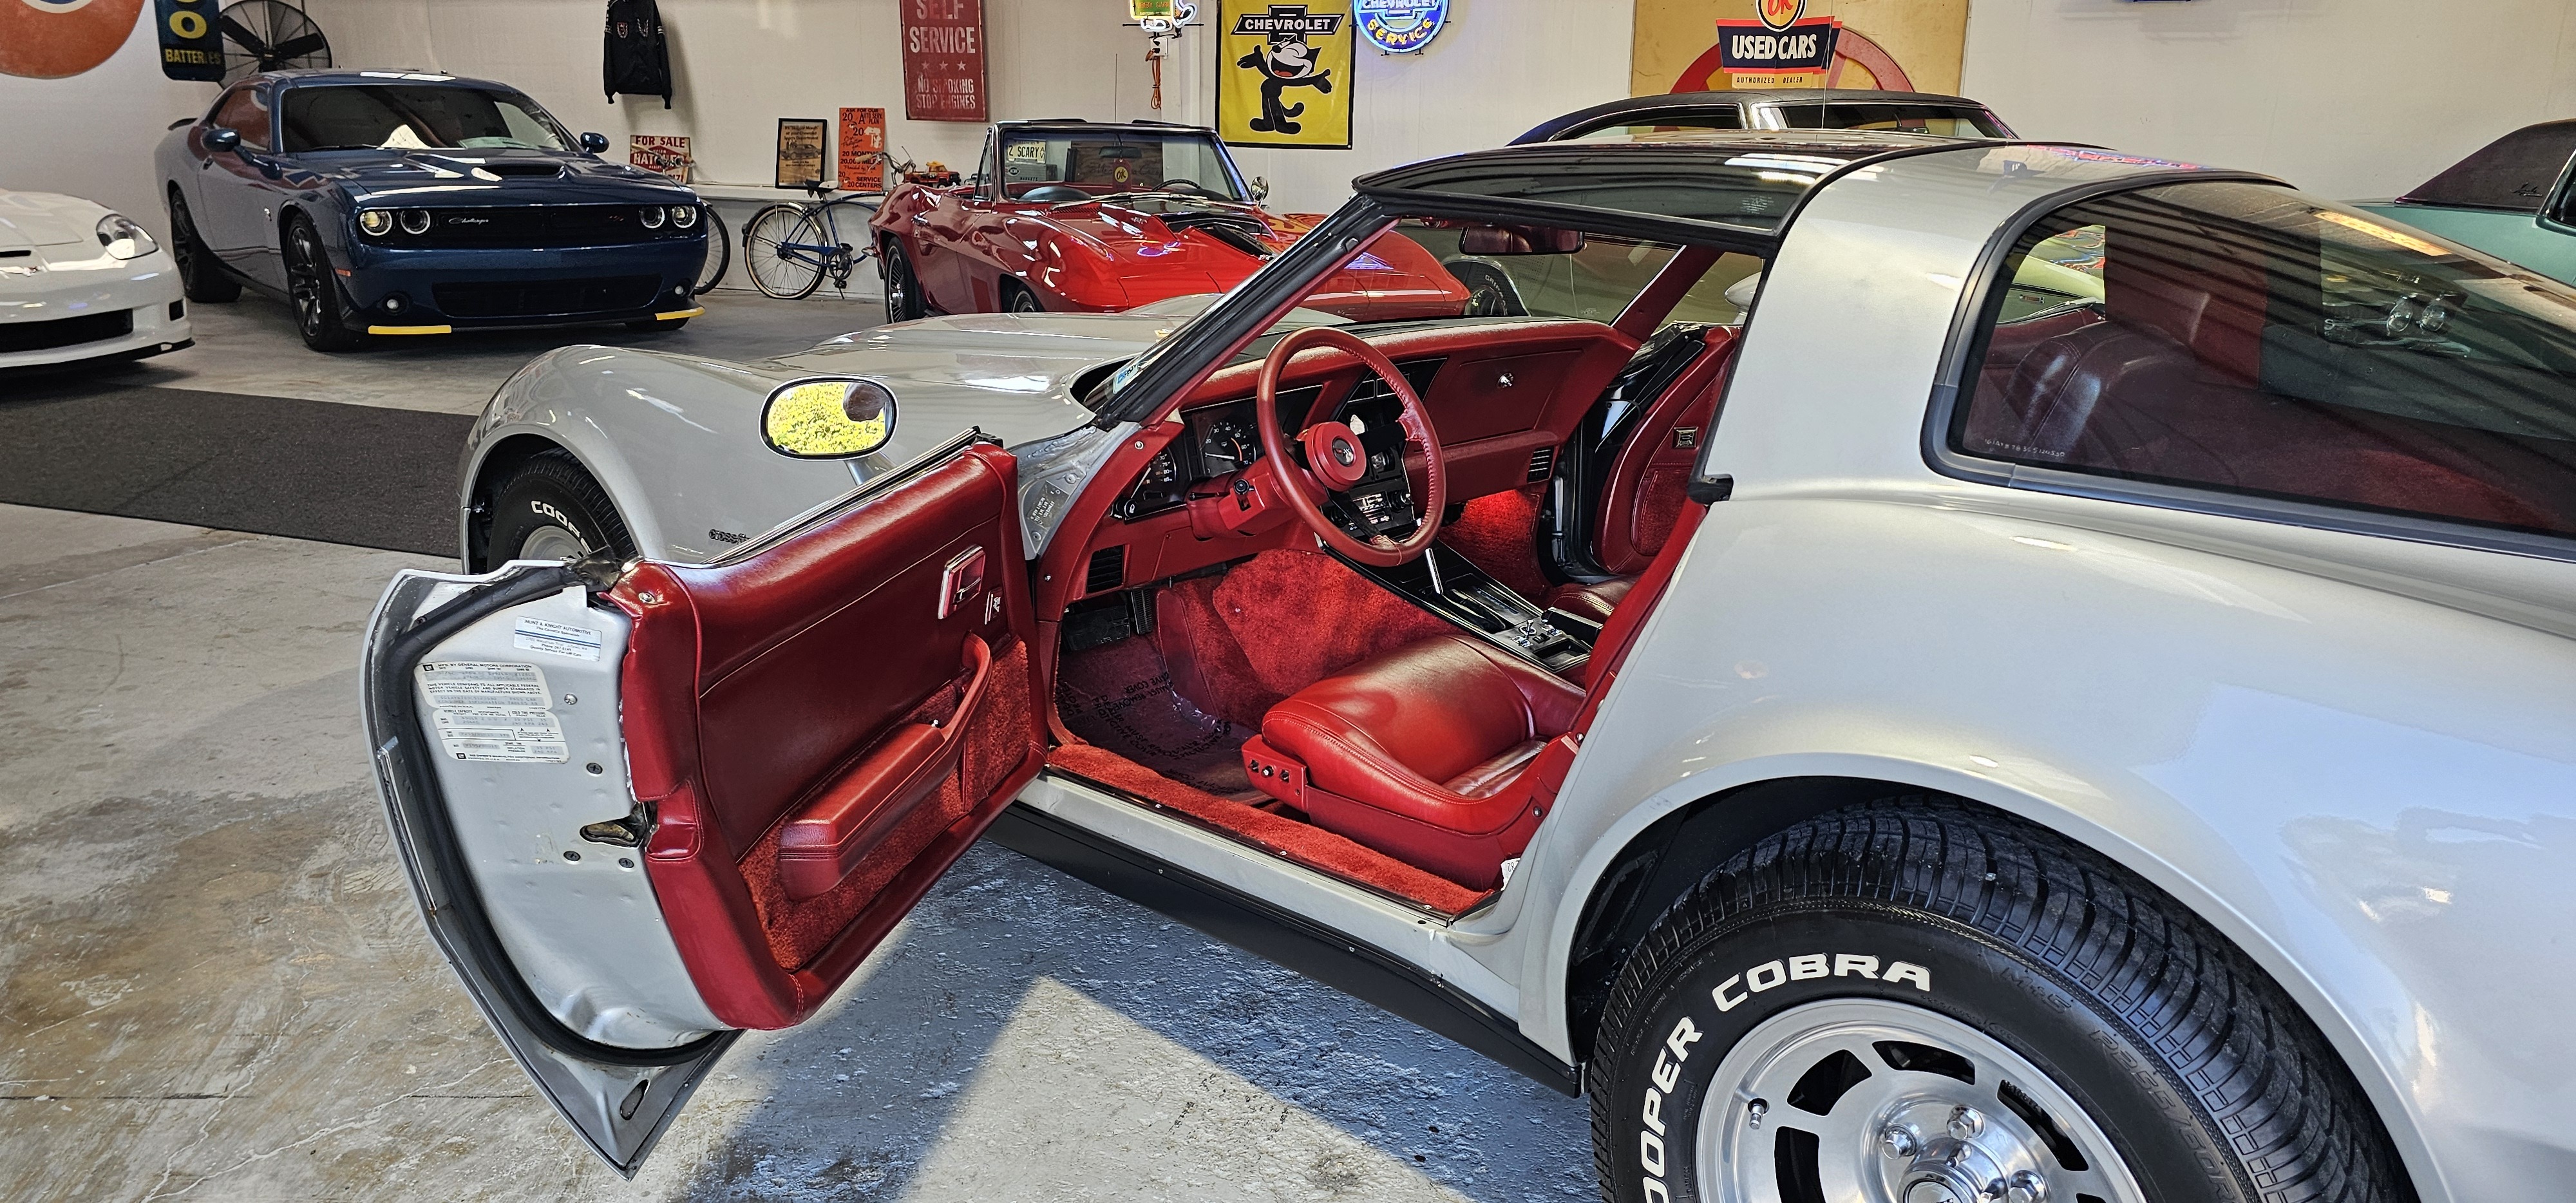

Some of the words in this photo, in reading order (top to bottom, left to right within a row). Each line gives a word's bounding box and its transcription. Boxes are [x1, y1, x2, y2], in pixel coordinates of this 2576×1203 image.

[917, 0, 963, 19] SELF
[1245, 18, 1331, 31] CHEVROLET
[1367, 17, 1436, 45] SERVICE
[909, 26, 976, 53] SERVICE
[1732, 35, 1777, 60] USED
[1778, 34, 1817, 60] CARS
[918, 77, 929, 93] NO
[916, 94, 937, 109] STOP
[941, 95, 976, 109] ENGINES
[842, 112, 853, 121] 20
[853, 128, 864, 136] 20
[636, 135, 656, 146] FOR
[660, 137, 685, 148] SALE
[1009, 145, 1014, 156] 2
[1018, 146, 1039, 158] SCARY
[1116, 169, 1126, 180] OK
[1711, 953, 1931, 1012] COBRA
